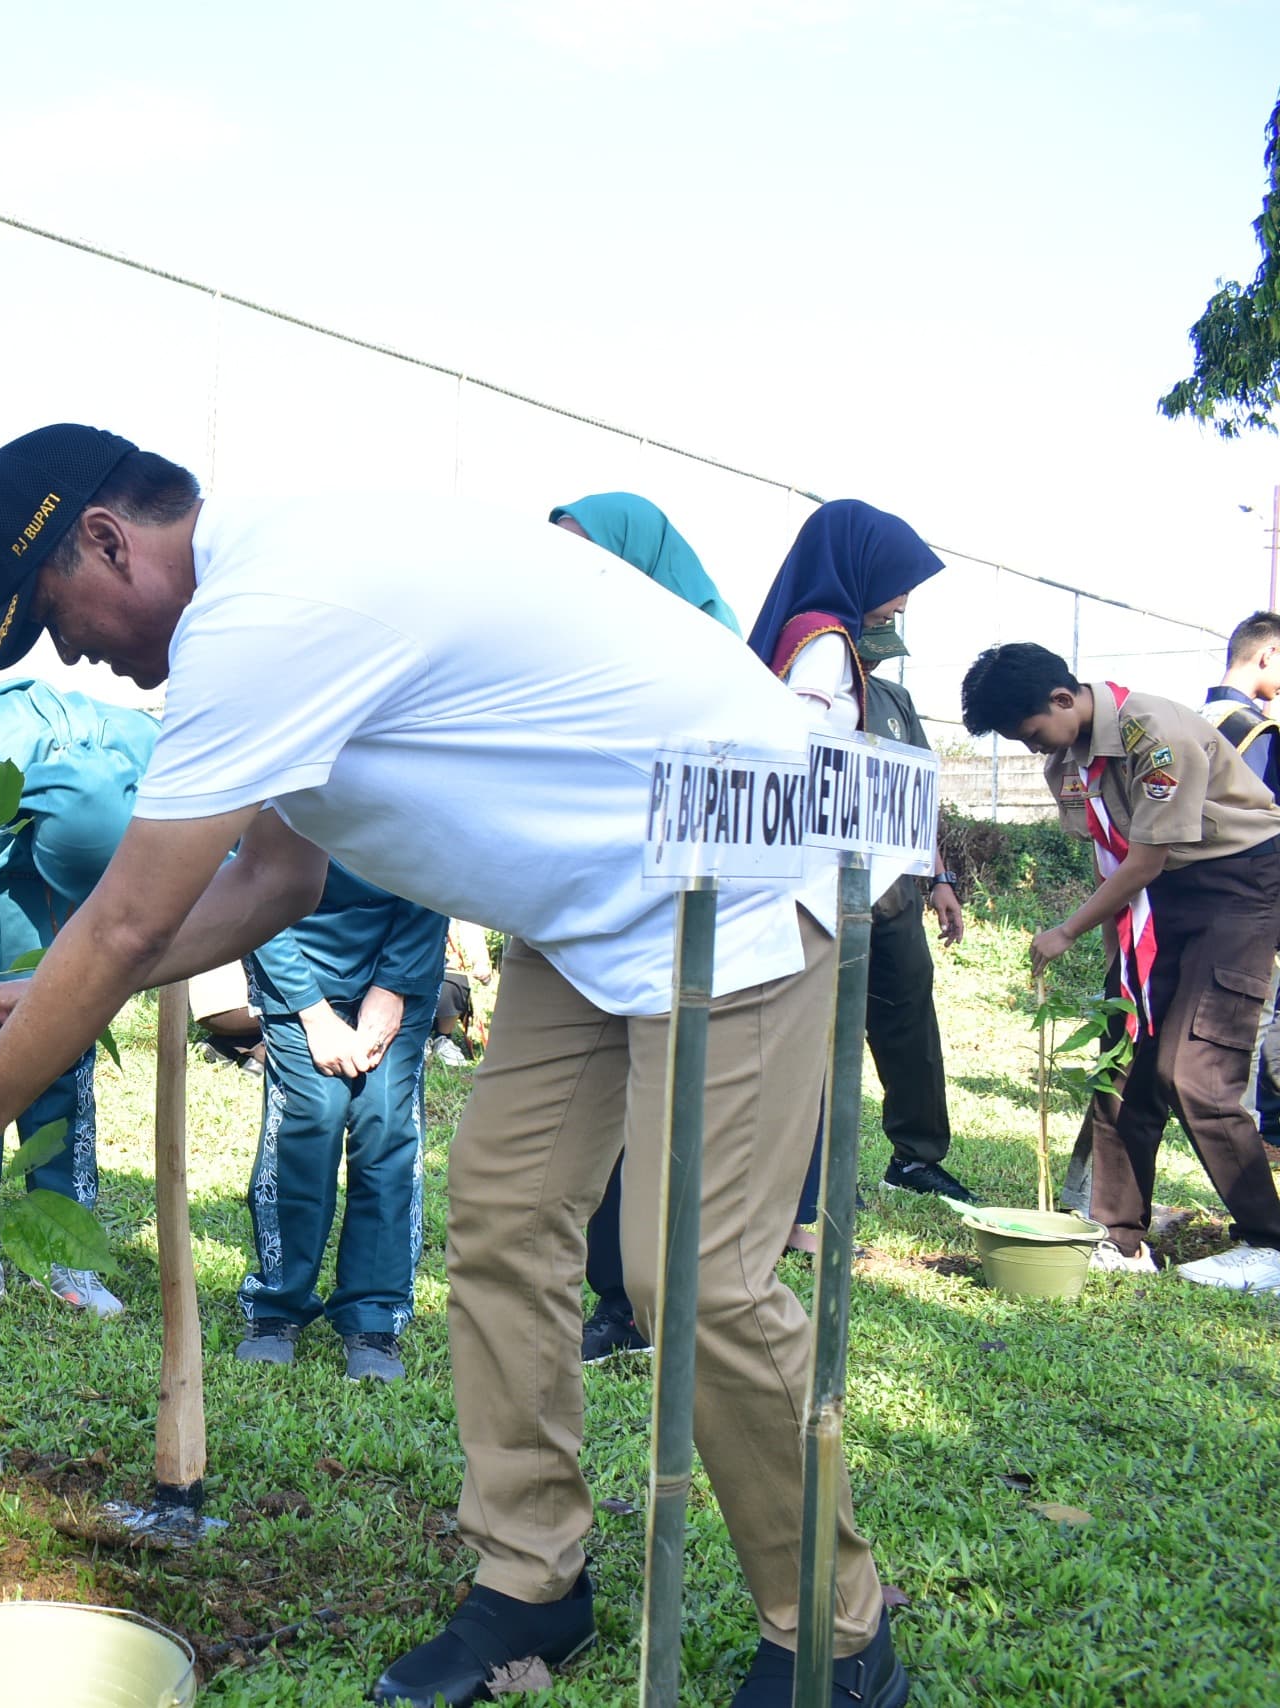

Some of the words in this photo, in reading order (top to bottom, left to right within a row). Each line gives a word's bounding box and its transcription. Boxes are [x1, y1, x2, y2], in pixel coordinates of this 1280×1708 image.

[23, 492, 61, 541] BUPATI
[676, 764, 755, 844] BUPATI
[762, 771, 805, 846] OKI
[805, 744, 860, 840] KETUA
[911, 767, 935, 851] OKI
